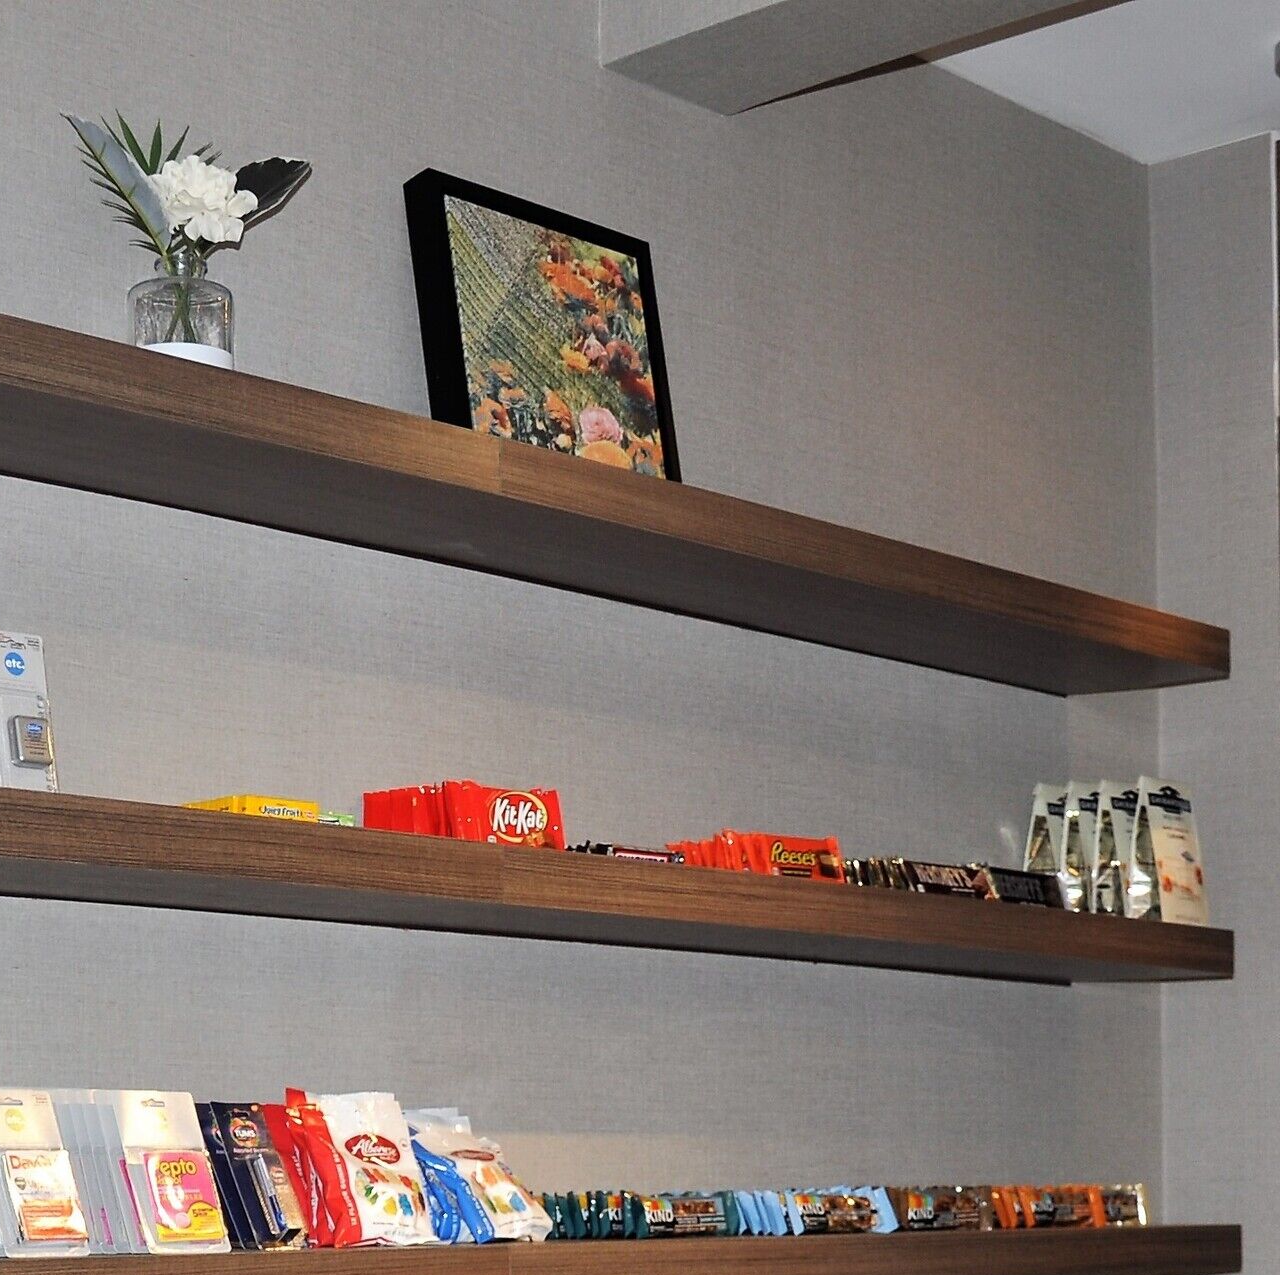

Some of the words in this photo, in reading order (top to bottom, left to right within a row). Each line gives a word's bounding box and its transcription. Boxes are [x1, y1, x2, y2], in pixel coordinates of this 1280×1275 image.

[5, 659, 26, 670] etc.
[233, 1128, 256, 1139] TUMS
[157, 1158, 197, 1178] epto
[799, 1204, 825, 1215] KIND
[907, 1207, 934, 1219] KIND
[645, 1209, 674, 1224] KIND
